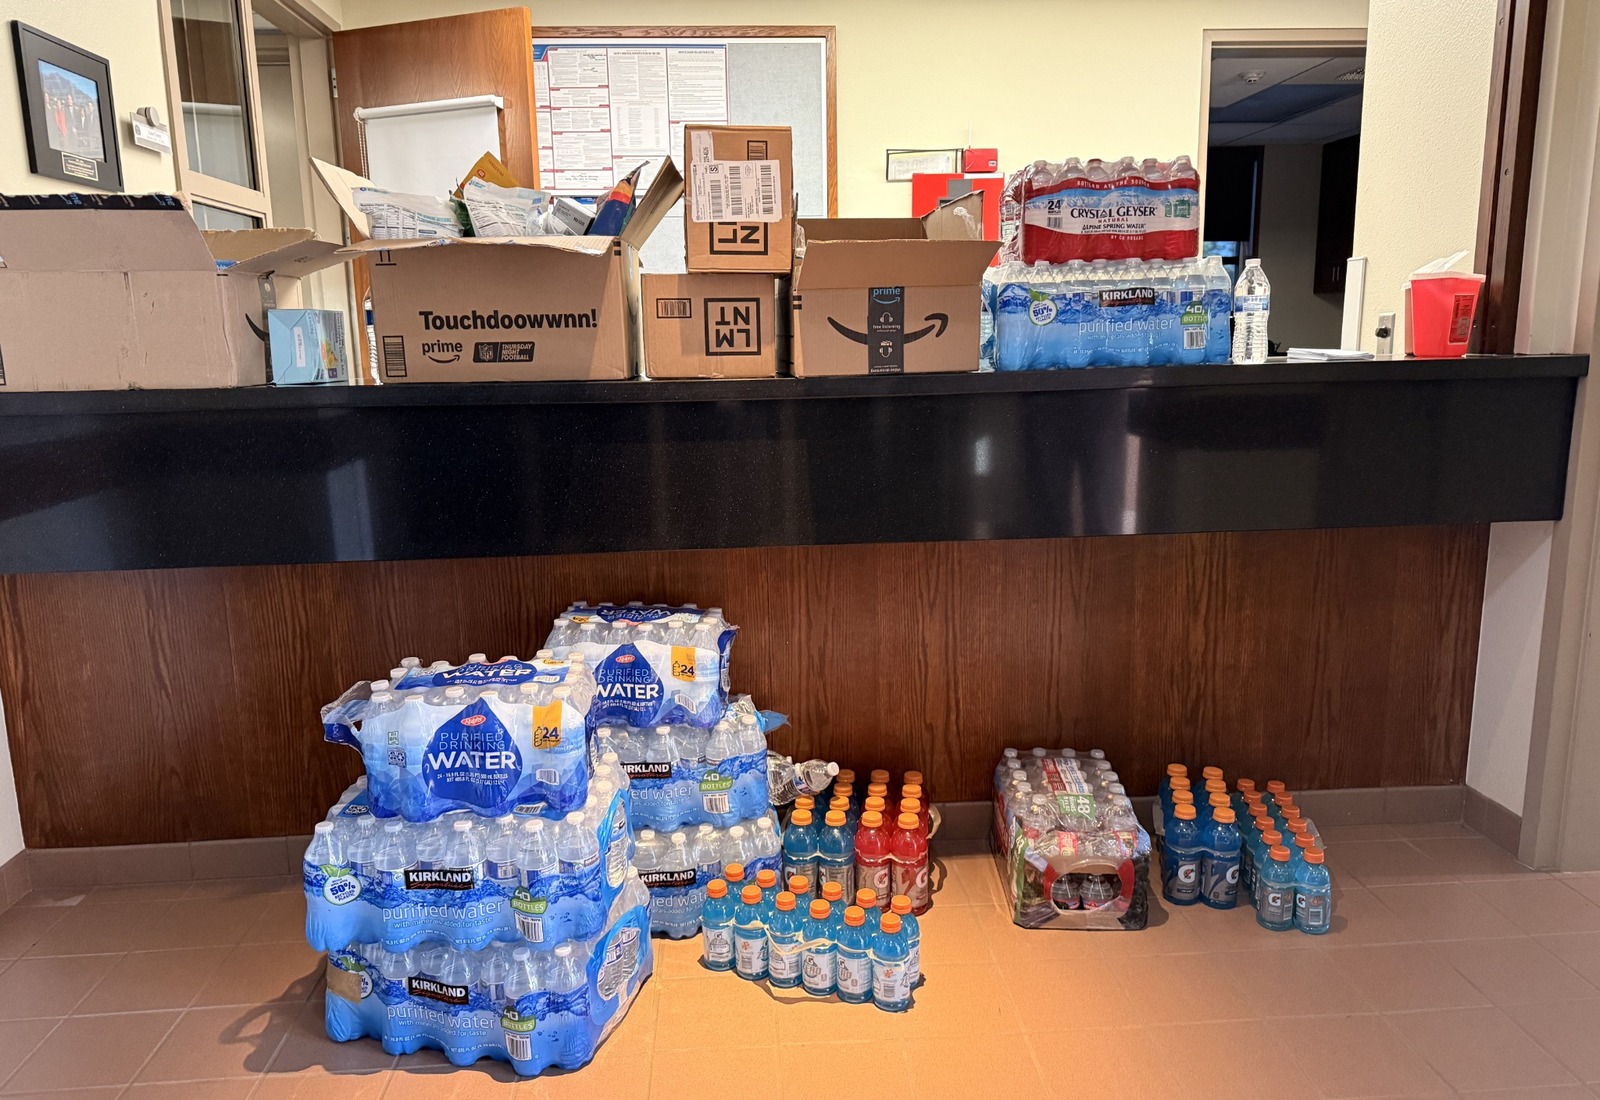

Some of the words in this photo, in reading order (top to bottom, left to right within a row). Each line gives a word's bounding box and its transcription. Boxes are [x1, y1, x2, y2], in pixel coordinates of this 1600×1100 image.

[1047, 200, 1062, 210] 24
[1070, 207, 1115, 219] CRYSTAL
[1116, 206, 1156, 217] GEYSER
[873, 287, 901, 297] prime
[1102, 289, 1153, 300] KIRKLAND
[1185, 305, 1203, 314] 40
[418, 309, 598, 331] Touchdoowwnn!
[1079, 318, 1133, 335] purified
[1137, 318, 1175, 331] water
[421, 340, 463, 356] prime
[442, 669, 533, 680] WATER
[600, 668, 649, 677] PURIFIED
[680, 665, 695, 676] 24
[598, 675, 651, 684] DRINKING
[596, 683, 660, 700] WATER
[440, 732, 504, 742] PURIFIED
[542, 726, 559, 739] 24
[439, 740, 505, 751] DRINKING
[427, 751, 517, 771] WATER
[703, 773, 720, 781] 40
[701, 781, 731, 790] BOTTLES
[652, 785, 693, 800] water
[1077, 796, 1091, 814] 48
[409, 871, 472, 883] KIRKLAND
[641, 870, 695, 883] KIRKLAND
[874, 869, 889, 889] G
[1178, 864, 1195, 884] G
[330, 881, 356, 896] 50%
[515, 889, 530, 901] 40
[513, 900, 545, 911] BOTTLES
[678, 891, 708, 907] wat
[1268, 892, 1281, 907] G
[382, 903, 448, 922] purified
[452, 901, 503, 920] water
[394, 921, 410, 929] with
[474, 917, 494, 926] taste
[411, 978, 466, 998] KIRKLAND
[387, 1004, 445, 1025] purified
[448, 1014, 496, 1029] water
[503, 1009, 518, 1021] 40
[502, 1017, 534, 1030] BOTTLES
[457, 1029, 467, 1037] for
[468, 1029, 487, 1037] taste
